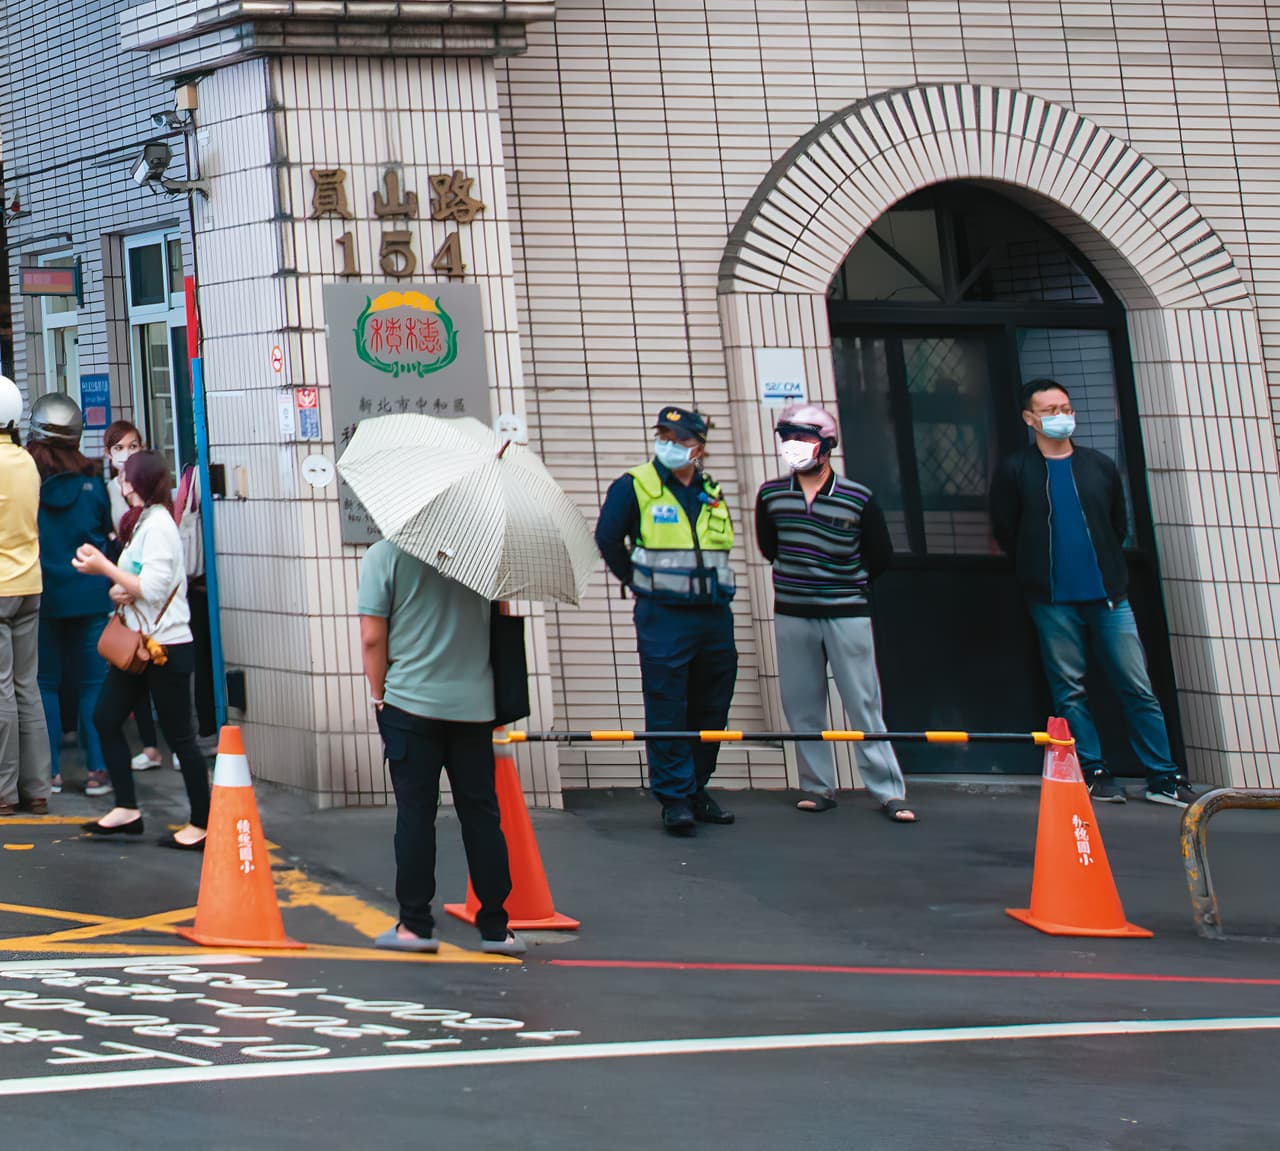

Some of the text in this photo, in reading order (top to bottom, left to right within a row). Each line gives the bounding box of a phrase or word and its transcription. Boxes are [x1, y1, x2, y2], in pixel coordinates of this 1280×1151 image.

[309, 167, 486, 224] 員山路
[334, 230, 468, 278] 154
[359, 396, 466, 414] 新北市中和區
